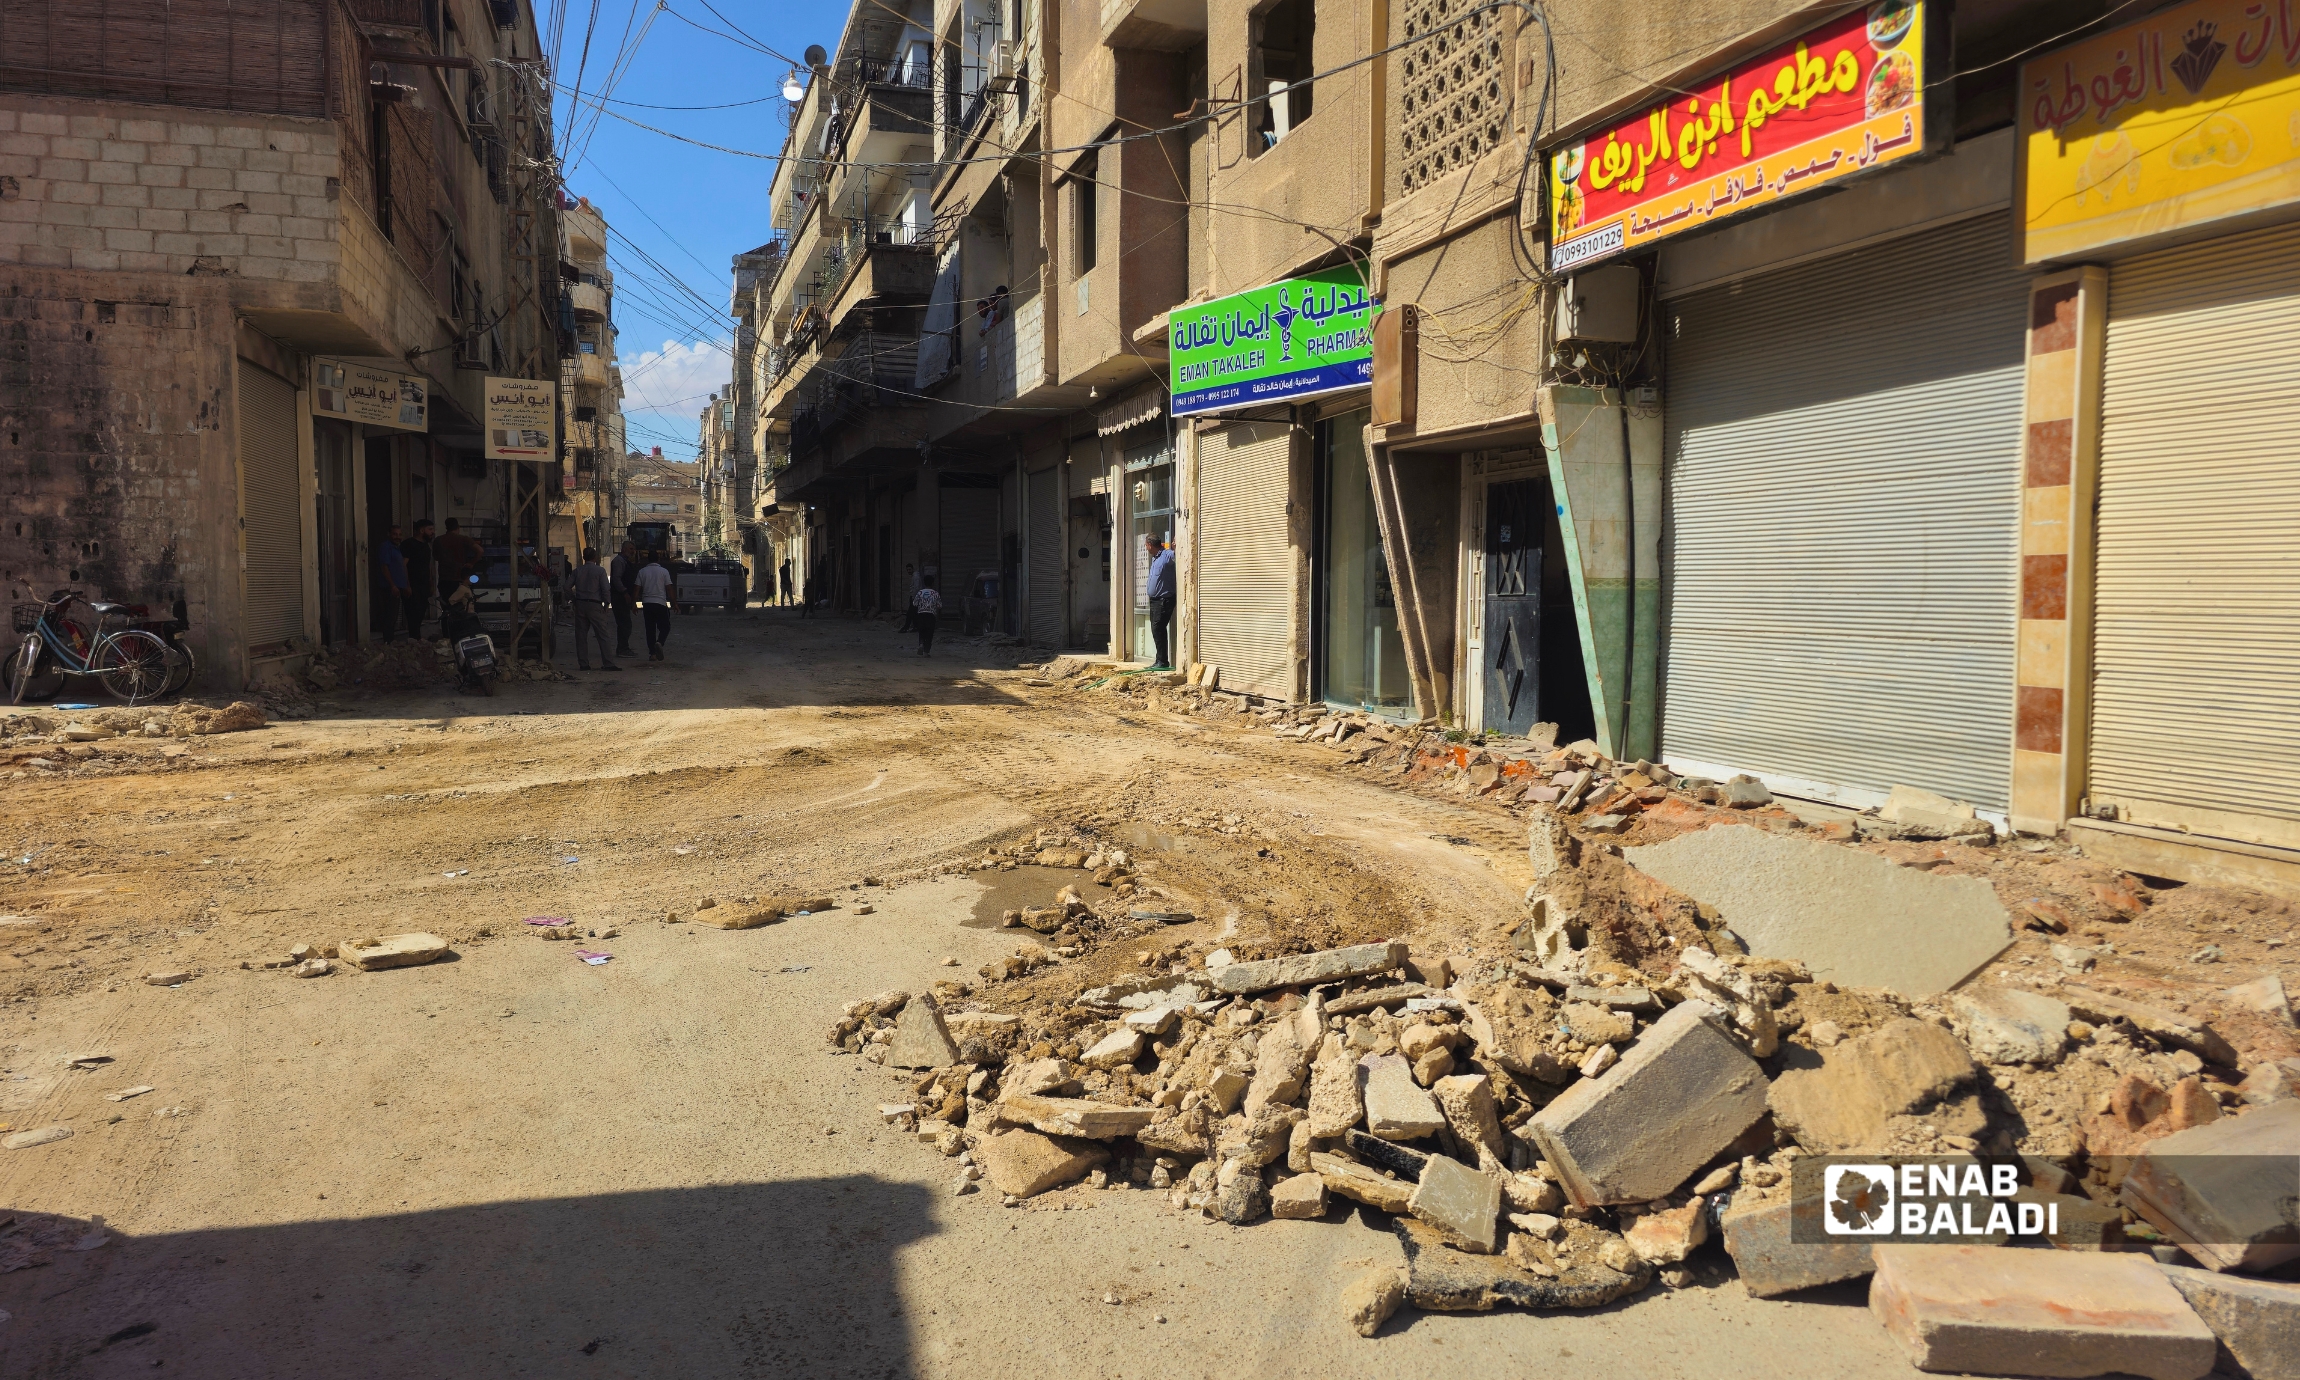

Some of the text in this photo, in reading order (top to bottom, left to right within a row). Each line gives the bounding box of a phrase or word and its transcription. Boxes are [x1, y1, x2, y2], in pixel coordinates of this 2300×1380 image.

[2034, 31, 2166, 132] الغوطة
[1590, 41, 1859, 194] مطعم ابن الريف
[1859, 114, 1913, 167] فول
[1777, 149, 1843, 194] حمص
[1705, 168, 1764, 216] فلافل
[1630, 202, 1694, 236] مسبحة
[1564, 228, 1623, 262] 0993101229
[1222, 303, 1270, 347] إيمان
[1302, 286, 1382, 327] يدلية
[356, 371, 389, 383] مفروشات
[1180, 350, 1265, 383] EMAN TAKALEH
[379, 387, 397, 403] أبو
[501, 382, 539, 391] مفروشات
[528, 393, 550, 407] أبو
